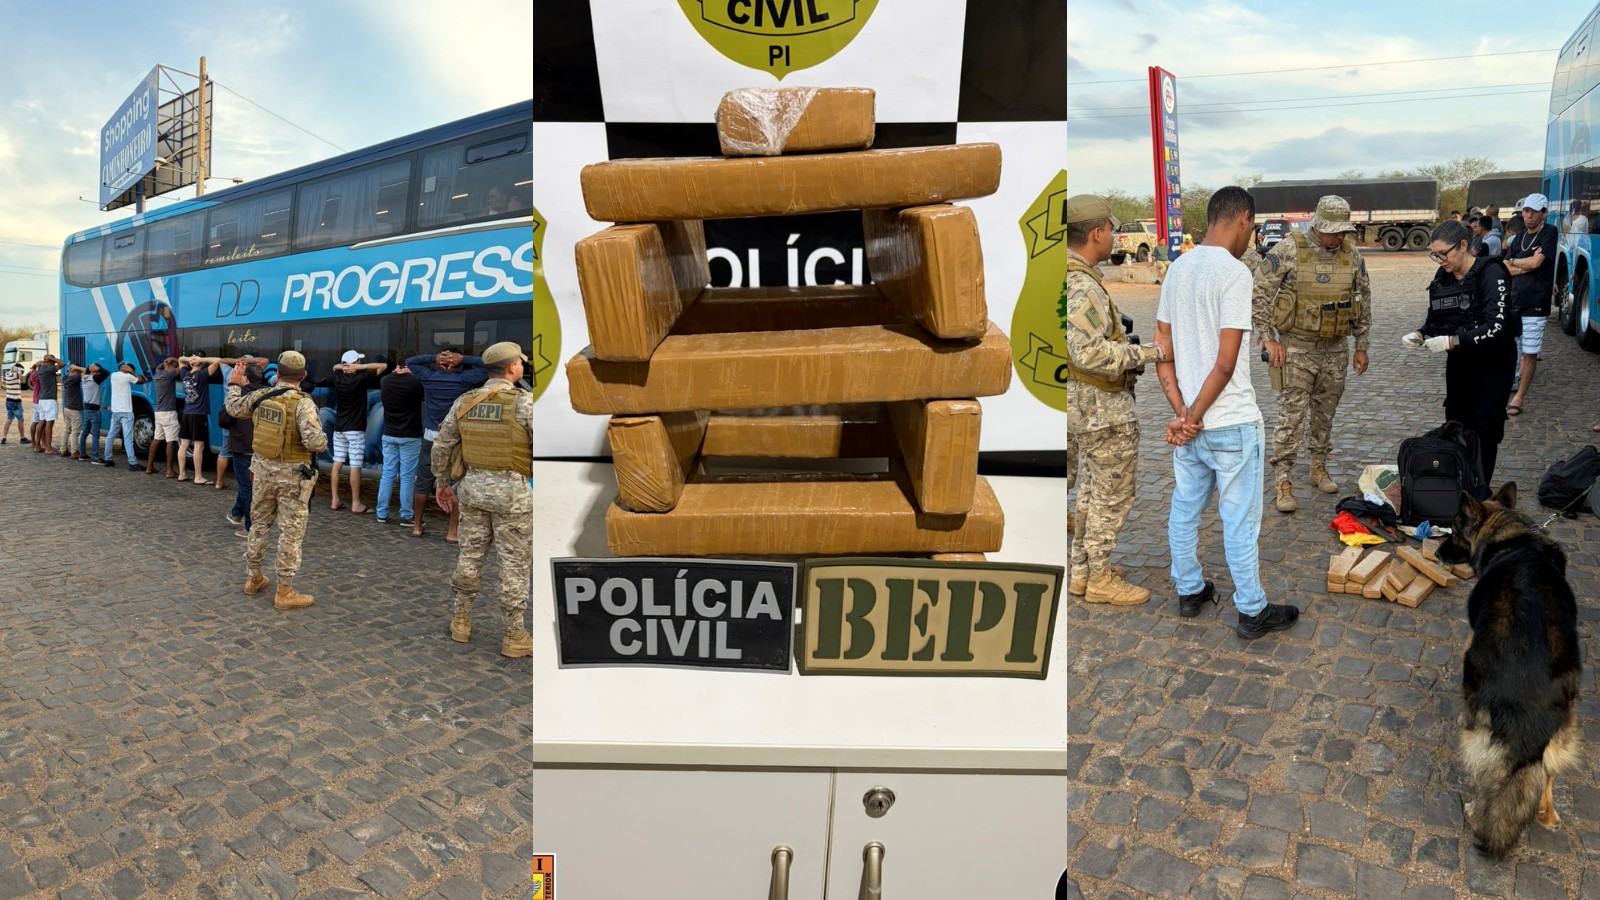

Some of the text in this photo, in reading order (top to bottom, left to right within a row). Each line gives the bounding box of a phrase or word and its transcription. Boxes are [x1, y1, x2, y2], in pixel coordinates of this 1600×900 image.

[727, 0, 829, 28] CIVIL
[769, 45, 790, 66] PI
[102, 123, 152, 184] CAMINHONEIRO
[281, 241, 533, 313] PROGRESS
[216, 279, 260, 318] DD
[227, 328, 258, 344] leito
[259, 407, 283, 423] BEPI
[469, 404, 501, 419] BEPI
[565, 569, 783, 620] POLÍCIA
[609, 618, 742, 659] CIVIL
[812, 578, 1049, 663] BEPI
